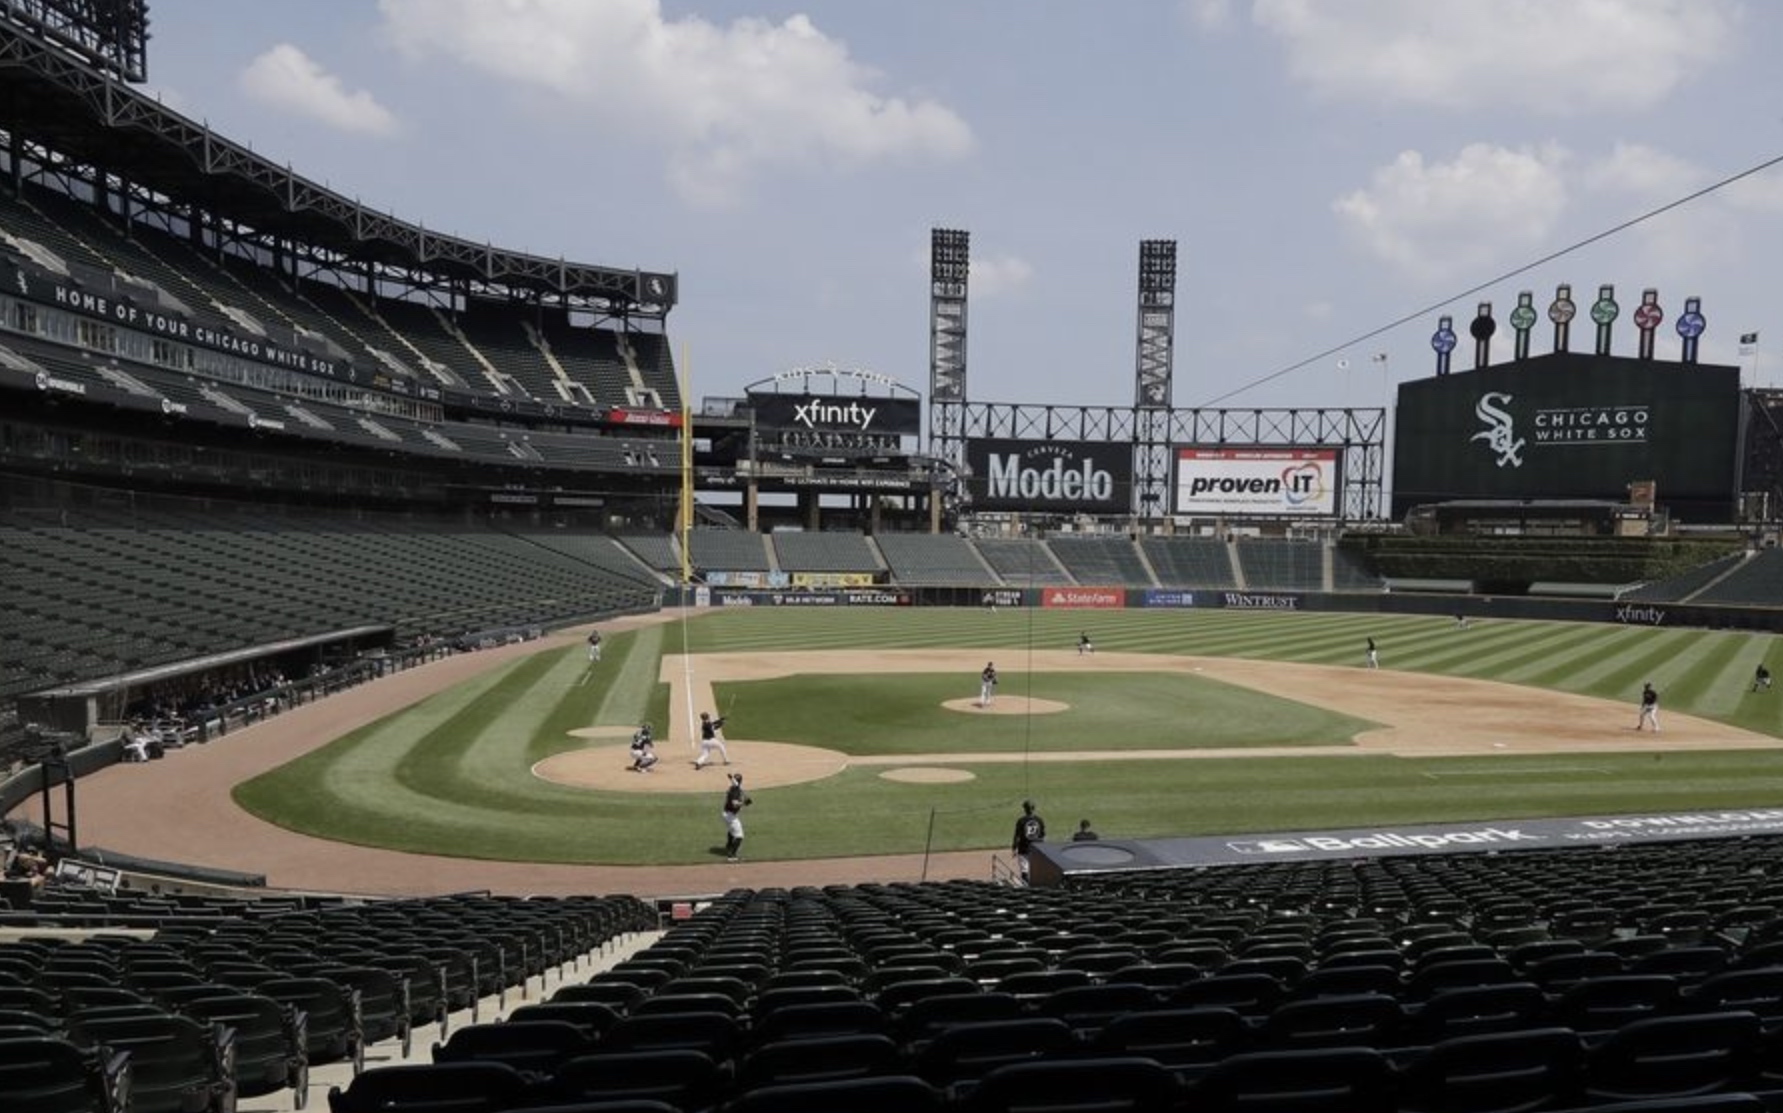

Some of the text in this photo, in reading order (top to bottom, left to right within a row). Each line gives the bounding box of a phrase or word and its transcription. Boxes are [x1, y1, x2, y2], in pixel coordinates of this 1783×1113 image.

[55, 285, 335, 375] HOME OF YOUR CHICAGO WHITE SOX
[794, 399, 876, 430] xfinity
[1535, 411, 1648, 427] CHICAGO
[1535, 427, 1645, 441] WHITE SOX
[1027, 445, 1074, 460] CERVEZA
[987, 453, 1113, 500] Modelo
[1190, 475, 1314, 496] proven IT
[1224, 593, 1299, 608] WINTRUST
[1616, 604, 1666, 625] xfinity
[1302, 827, 1527, 850] Ballpark
